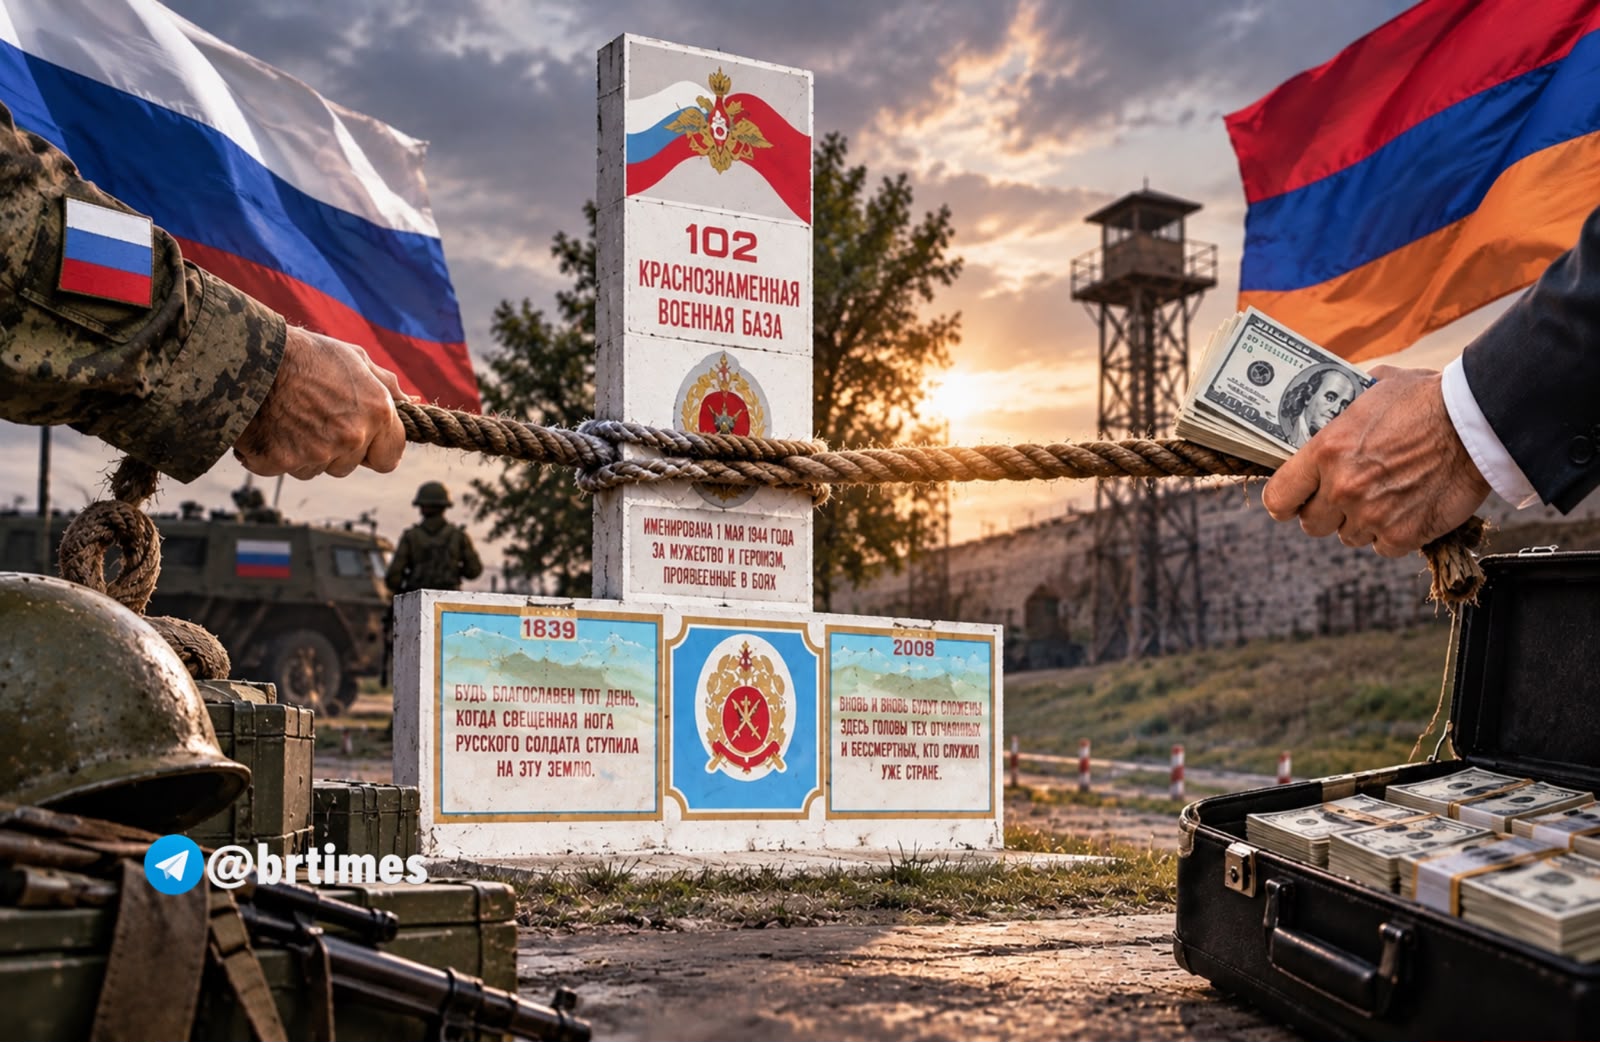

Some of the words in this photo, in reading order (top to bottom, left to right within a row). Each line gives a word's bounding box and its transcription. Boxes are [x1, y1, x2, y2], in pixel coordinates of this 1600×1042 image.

[686, 224, 757, 263] 102
[639, 259, 800, 307] КРАСНОЗНАМЕННАЯ
[658, 298, 734, 334] ВОЕННАЯ
[742, 309, 782, 340] БАЗА
[644, 517, 713, 540] ИМЕНИРОВАНА
[716, 523, 720, 540] 1
[724, 524, 744, 541] МАЯ
[748, 526, 767, 543] 1944
[771, 528, 794, 546] ГОДА
[652, 542, 665, 559] ЗА
[670, 544, 723, 563] МУЖЕСТВО
[728, 548, 734, 564] И
[741, 572, 747, 588] В
[752, 572, 776, 590] БОЯХ
[523, 618, 575, 639] 1839
[455, 684, 487, 703] БУДЬ
[493, 685, 575, 704] БЛАГОСЛАВЕН
[580, 688, 601, 704] ТОТ
[606, 689, 639, 708] ДЕНЬ,
[840, 696, 868, 712] ВНОВЬ
[872, 697, 878, 713] И
[912, 699, 938, 716] БУДУТ
[456, 709, 496, 728] КОГДА
[503, 710, 578, 730] СВЕЩЕННАЯ
[584, 712, 614, 730] НОГА
[841, 719, 869, 736] ЗДЕСЬ
[873, 720, 908, 736] ГОЛОВЫ
[912, 721, 927, 736] ТЕХ
[456, 735, 519, 752] РУССКОГО
[526, 736, 580, 755] СОЛДАТА
[586, 736, 639, 754] СТУПИЛА
[841, 742, 847, 757] И
[852, 742, 920, 760] БЕССМЕРТНЫХ,
[923, 743, 940, 758] КТО
[943, 744, 980, 759] СЛУЖИЛ
[497, 760, 513, 777] НА
[882, 765, 902, 780] УЖЕ
[906, 765, 942, 780] СТРАНЕ.
